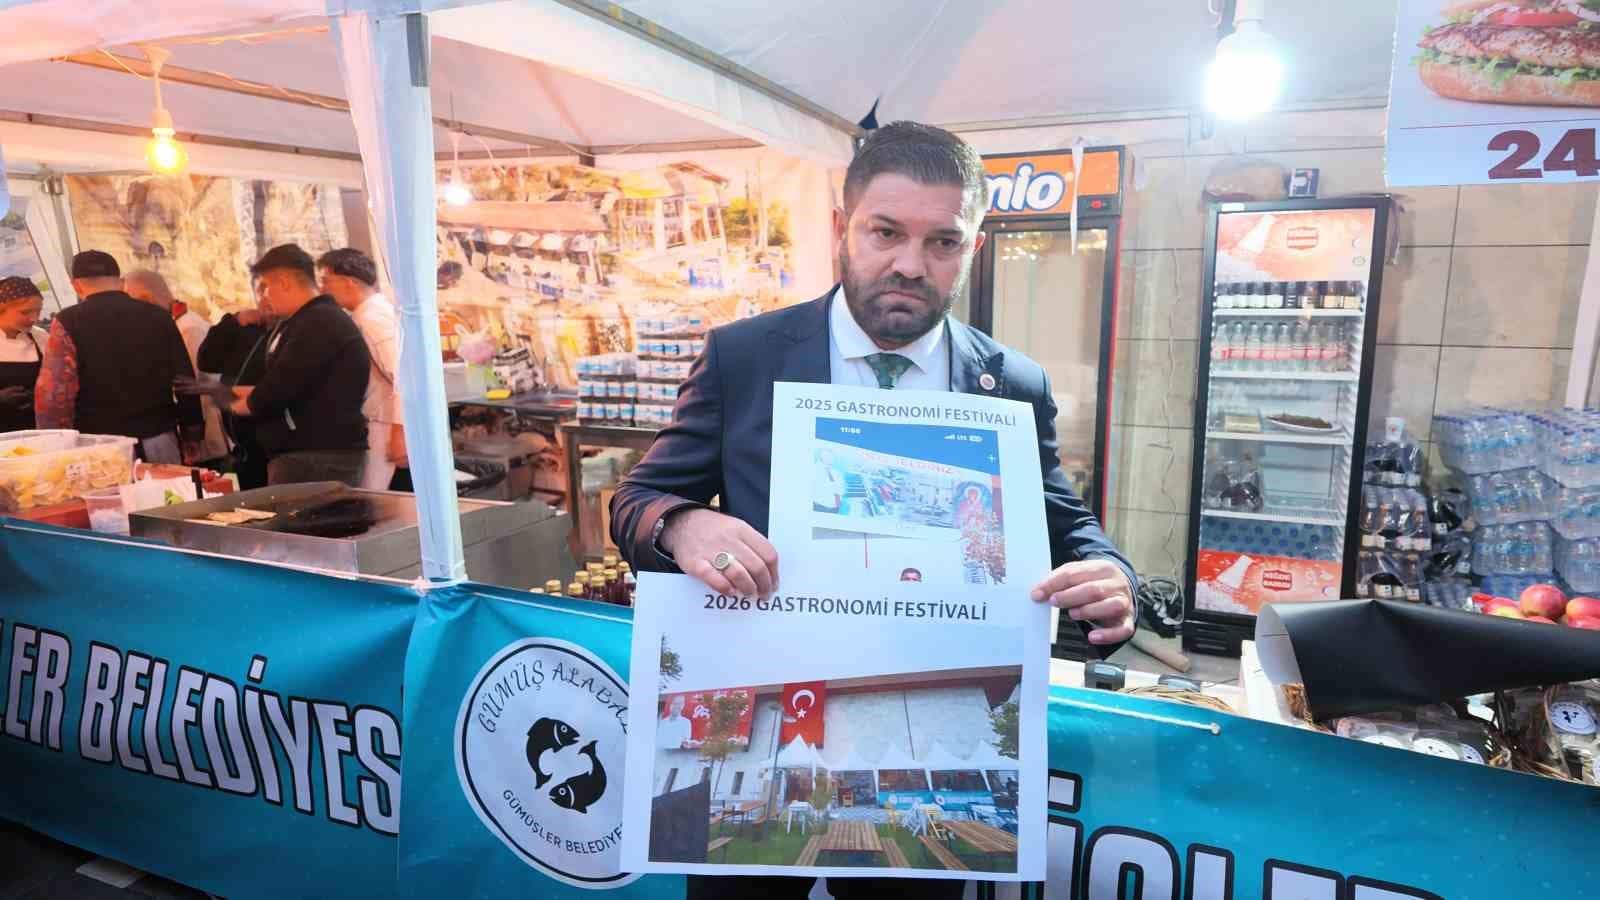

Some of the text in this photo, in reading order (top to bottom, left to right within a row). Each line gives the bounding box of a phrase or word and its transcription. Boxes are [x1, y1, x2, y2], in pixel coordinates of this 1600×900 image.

[1487, 128, 1600, 179] 24
[795, 398, 1017, 427] 2025 GASTRONOMİ FESTİVALİ
[703, 594, 987, 621] 2026 GASTRONOMİ FESTİVALİ
[478, 660, 545, 733] GÜMÜŞ
[552, 661, 628, 735] ALABA
[0, 620, 401, 836] ER BELEDİYES
[503, 789, 623, 854] GÜMÜŞLER BELEDİYE
